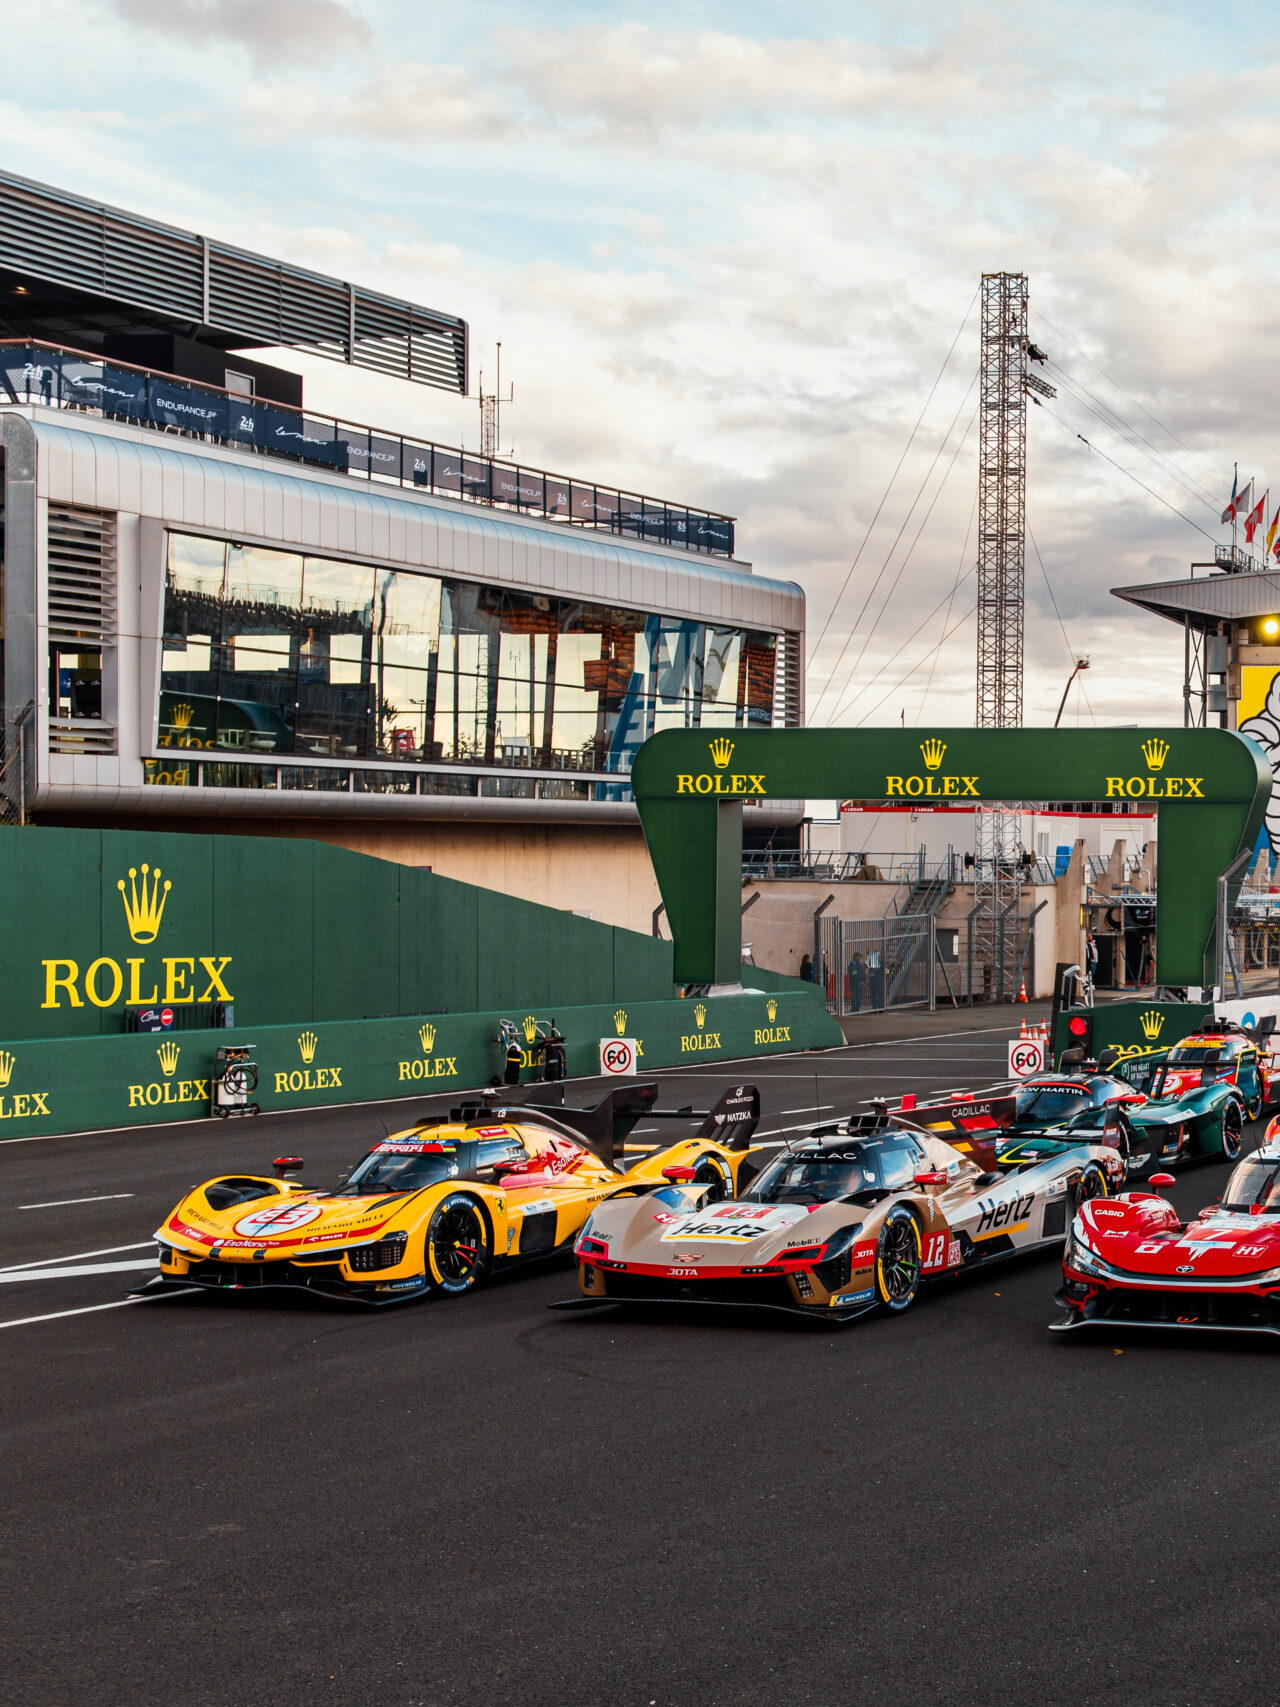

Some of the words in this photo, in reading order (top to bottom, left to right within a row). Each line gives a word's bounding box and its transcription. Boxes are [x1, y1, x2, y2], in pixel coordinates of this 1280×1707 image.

[676, 774, 767, 794] ROLEX
[886, 776, 980, 796] ROLEX
[1105, 777, 1204, 798] ROLEX
[40, 956, 234, 1008] ROLEX
[681, 1033, 721, 1051] ROLEX
[754, 1026, 791, 1044] ROLEX
[607, 1050, 627, 1065] 60
[1015, 1052, 1038, 1068] 60
[398, 1057, 458, 1081] ROLEX
[1137, 1071, 1150, 1079] RACING
[1138, 1063, 1150, 1071] HEART
[274, 1067, 342, 1093] ROLEX
[128, 1079, 210, 1107] ROLEX
[1040, 1087, 1083, 1096] MARTIN
[952, 1105, 991, 1118] CADILLAC
[373, 1143, 424, 1153] Ferrari
[976, 1191, 1033, 1233] Hertz
[1094, 1209, 1125, 1218] CASIO
[672, 1222, 771, 1238] Hertz
[1205, 1229, 1234, 1240] 7
[223, 1239, 267, 1248] EsaNano
[923, 1232, 944, 1268] 12
[1236, 1246, 1263, 1256] HY
[854, 1249, 874, 1258] JOTA
[667, 1268, 698, 1276] JOTA
